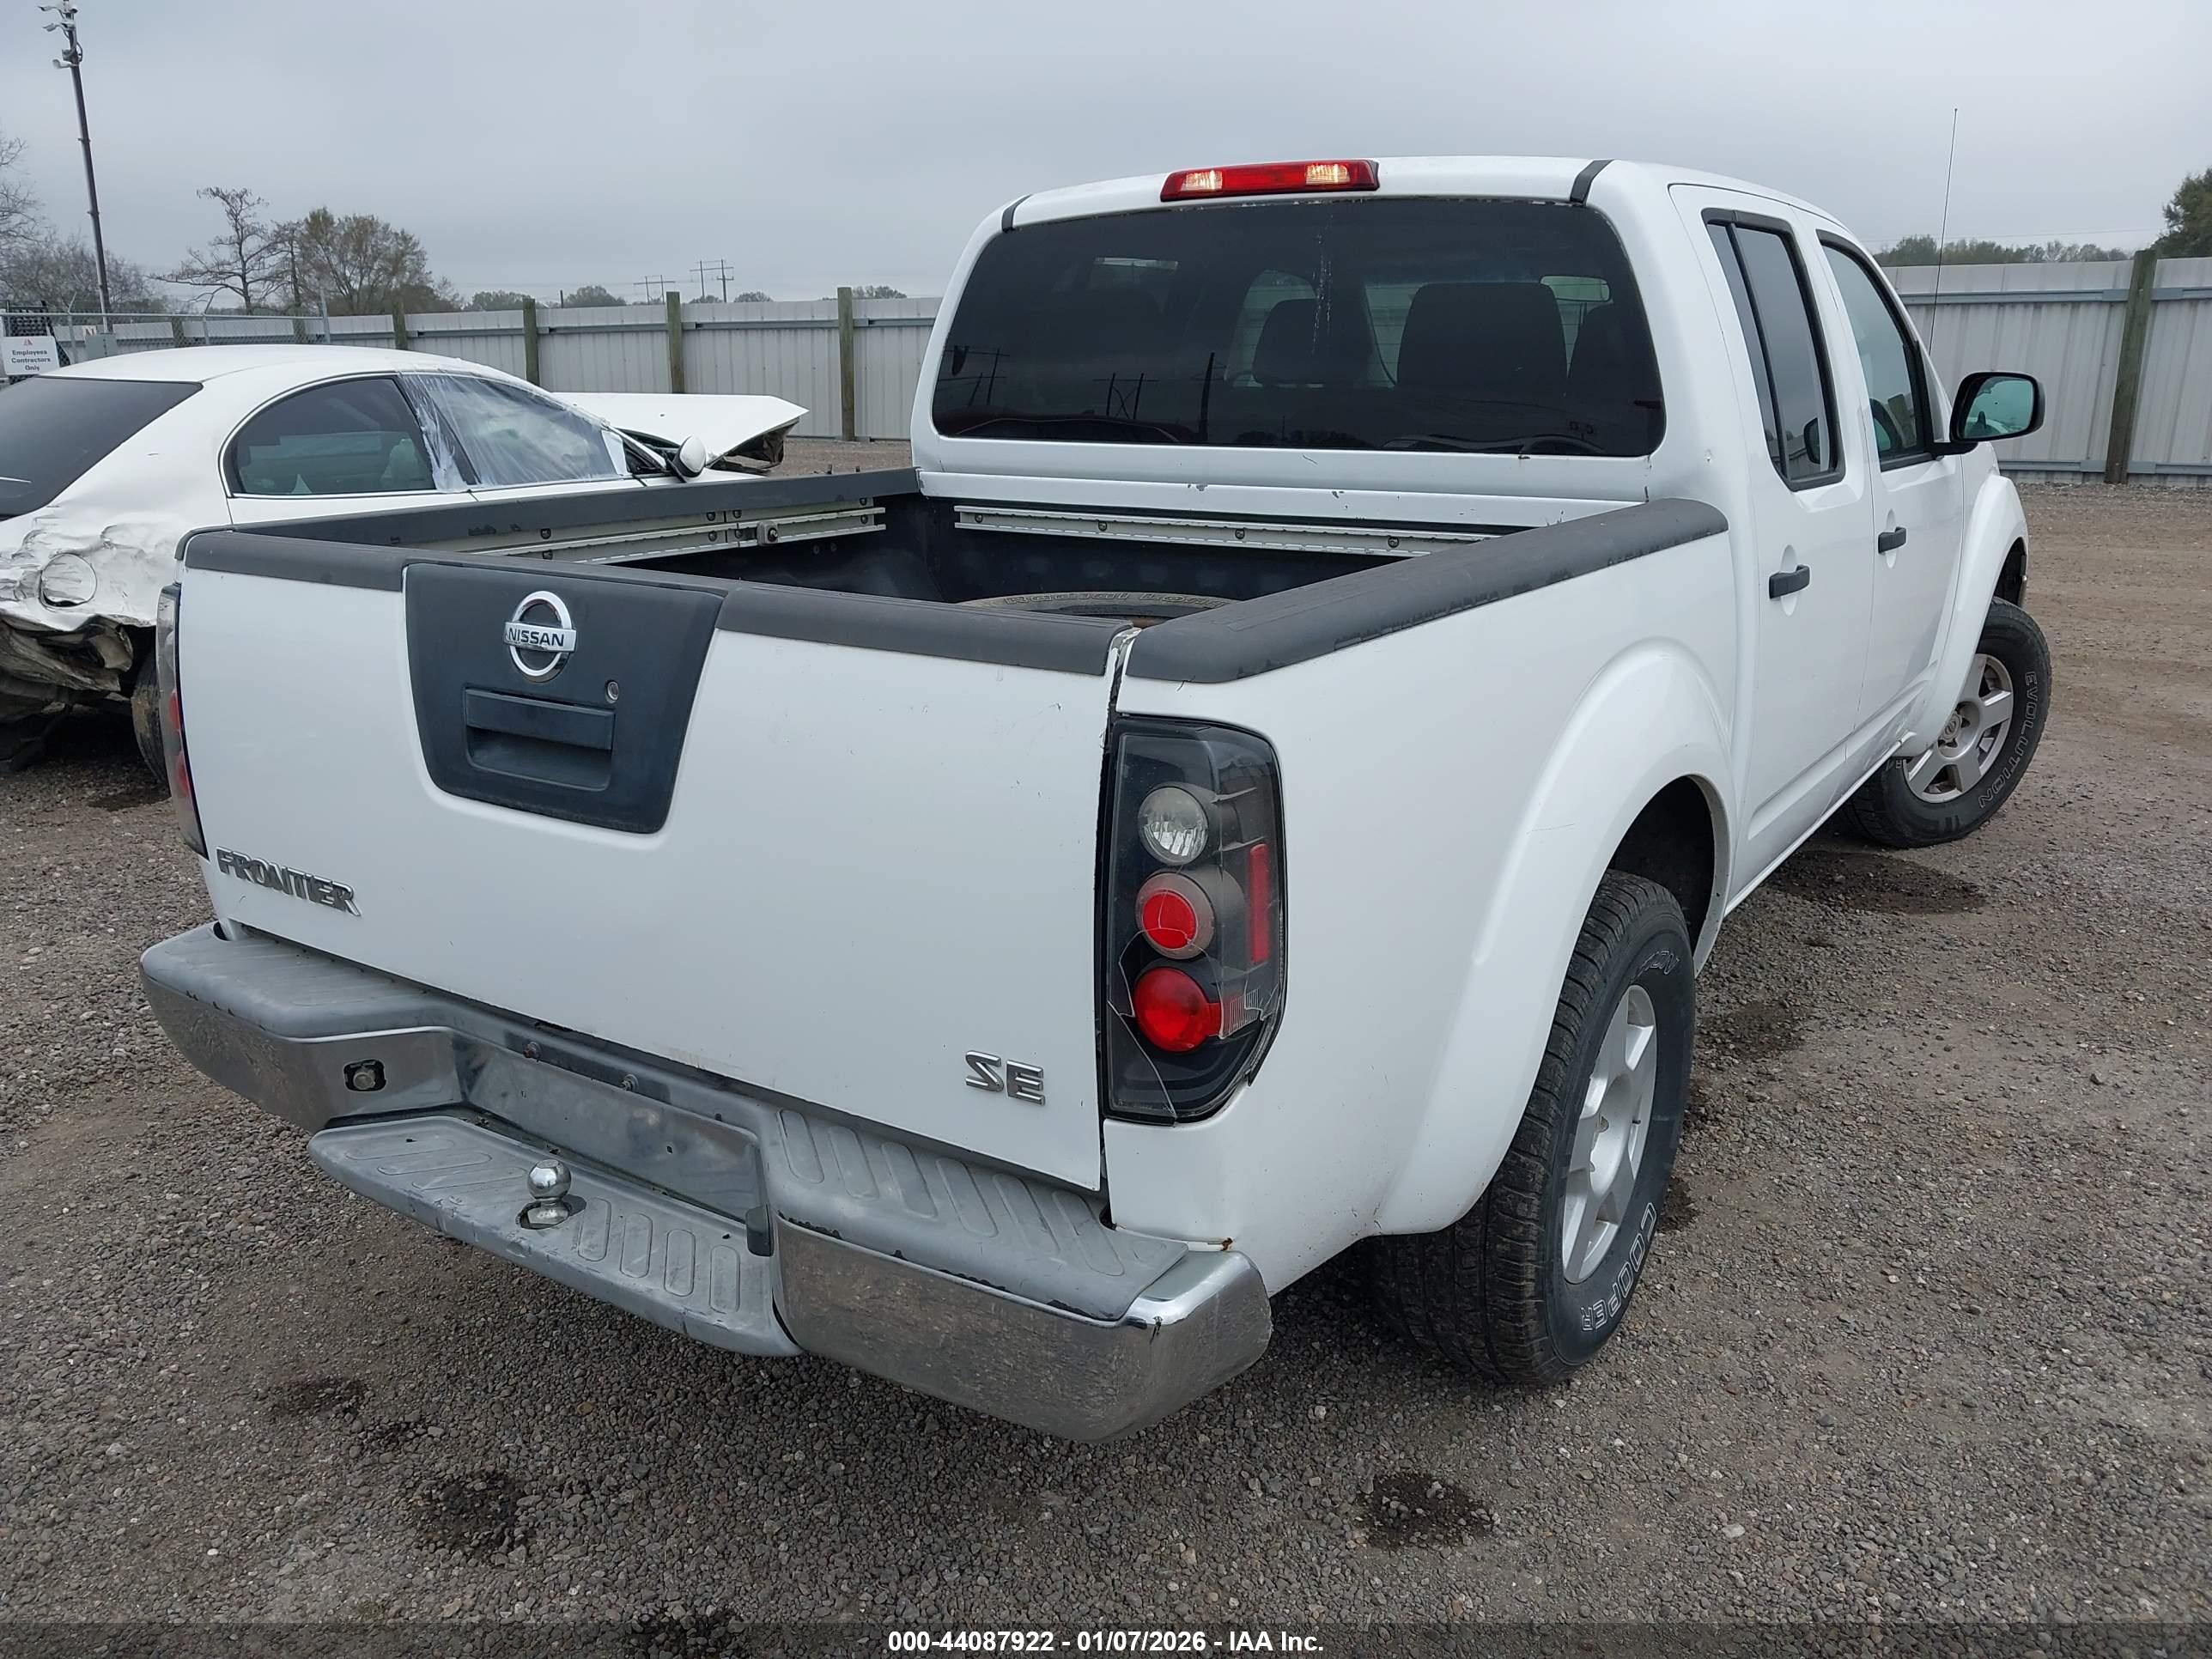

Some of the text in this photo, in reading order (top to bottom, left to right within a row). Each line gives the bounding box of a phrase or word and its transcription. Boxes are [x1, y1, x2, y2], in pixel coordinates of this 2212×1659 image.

[508, 628, 565, 647] NISSAN
[1978, 671, 2039, 809] EVOLUTION
[216, 846, 362, 916] FRONTIER
[965, 1050, 1045, 1106] SE
[1580, 1202, 1657, 1331] COOPER
